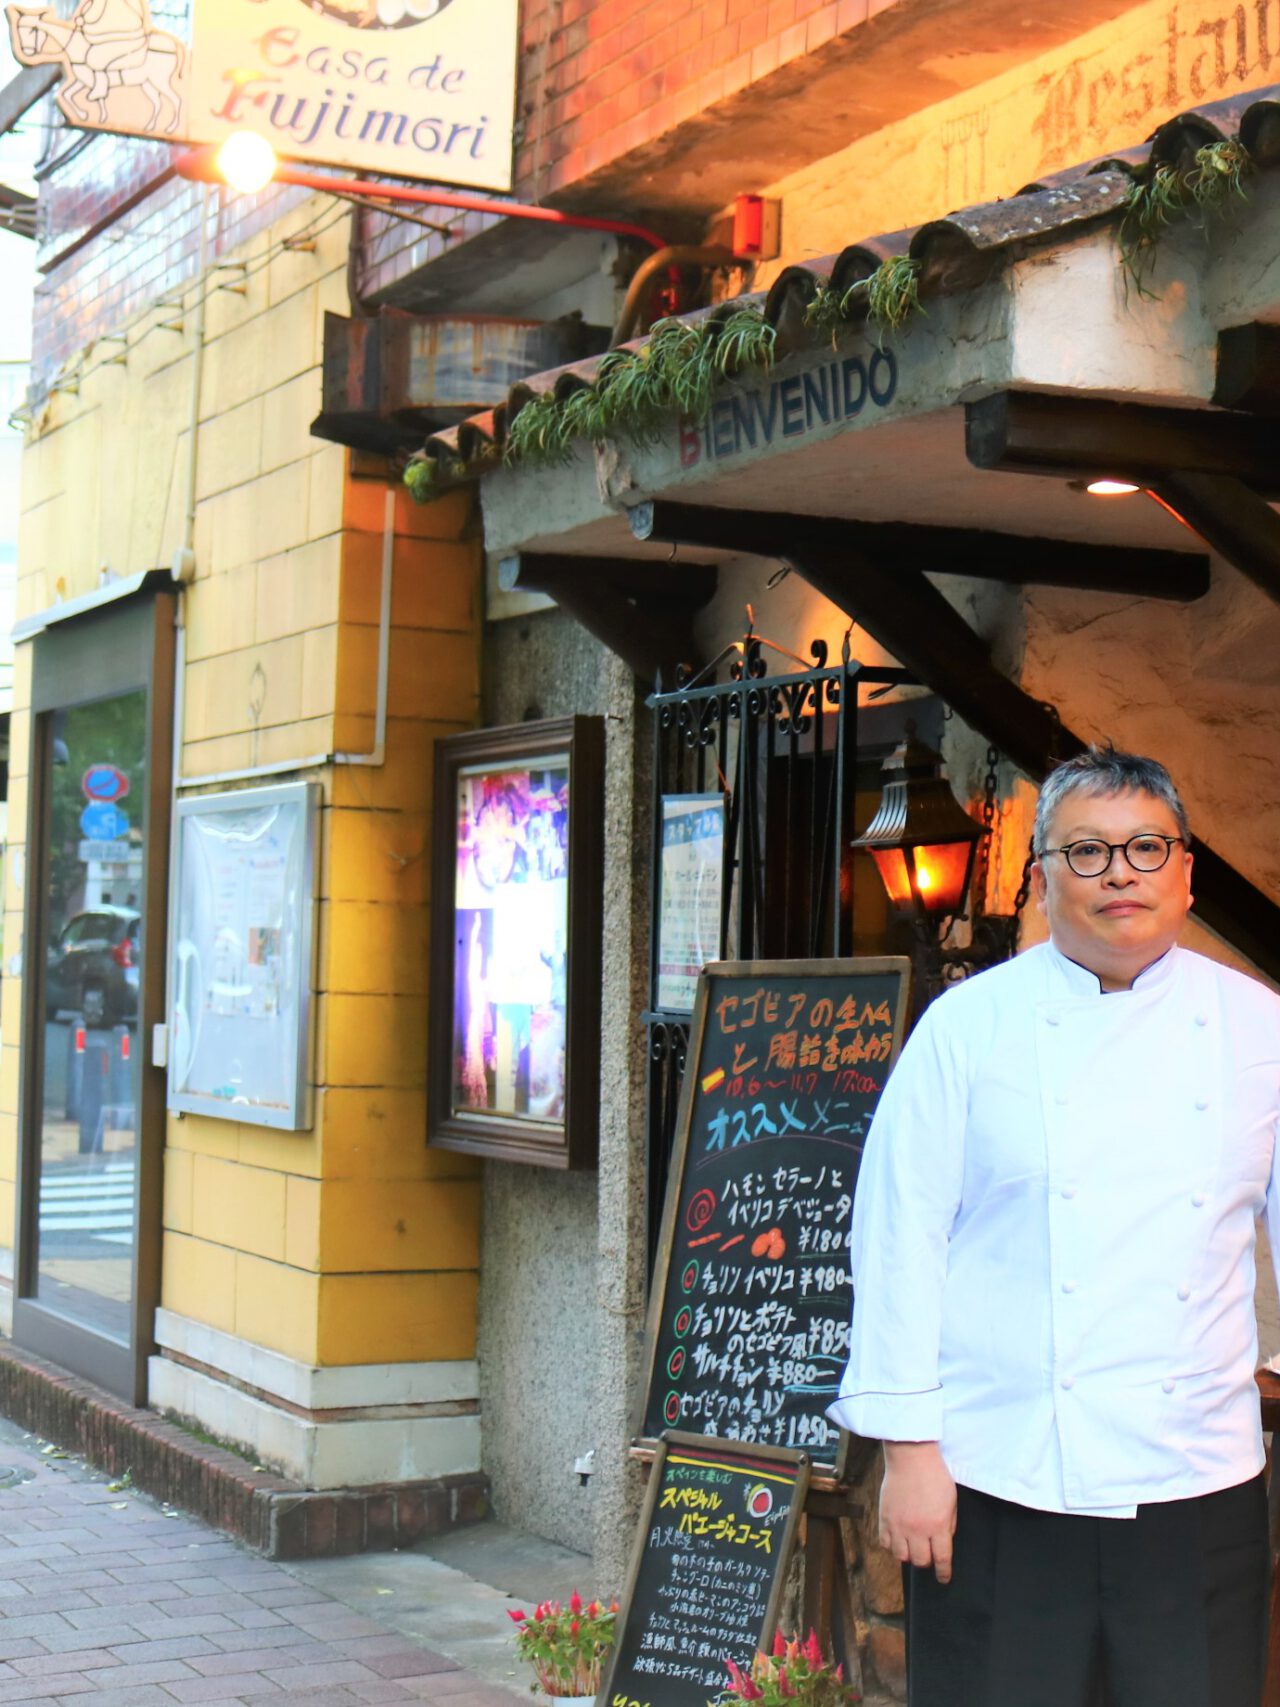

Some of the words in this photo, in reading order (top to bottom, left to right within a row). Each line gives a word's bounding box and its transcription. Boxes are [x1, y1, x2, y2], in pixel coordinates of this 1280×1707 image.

[252, 25, 390, 86] Casa
[407, 54, 466, 94] de
[210, 67, 489, 160] Fujimori
[678, 345, 898, 470] BIENVENIDO
[715, 987, 893, 1034] セゴビアの生ハム
[659, 1487, 723, 1511] スペシャル
